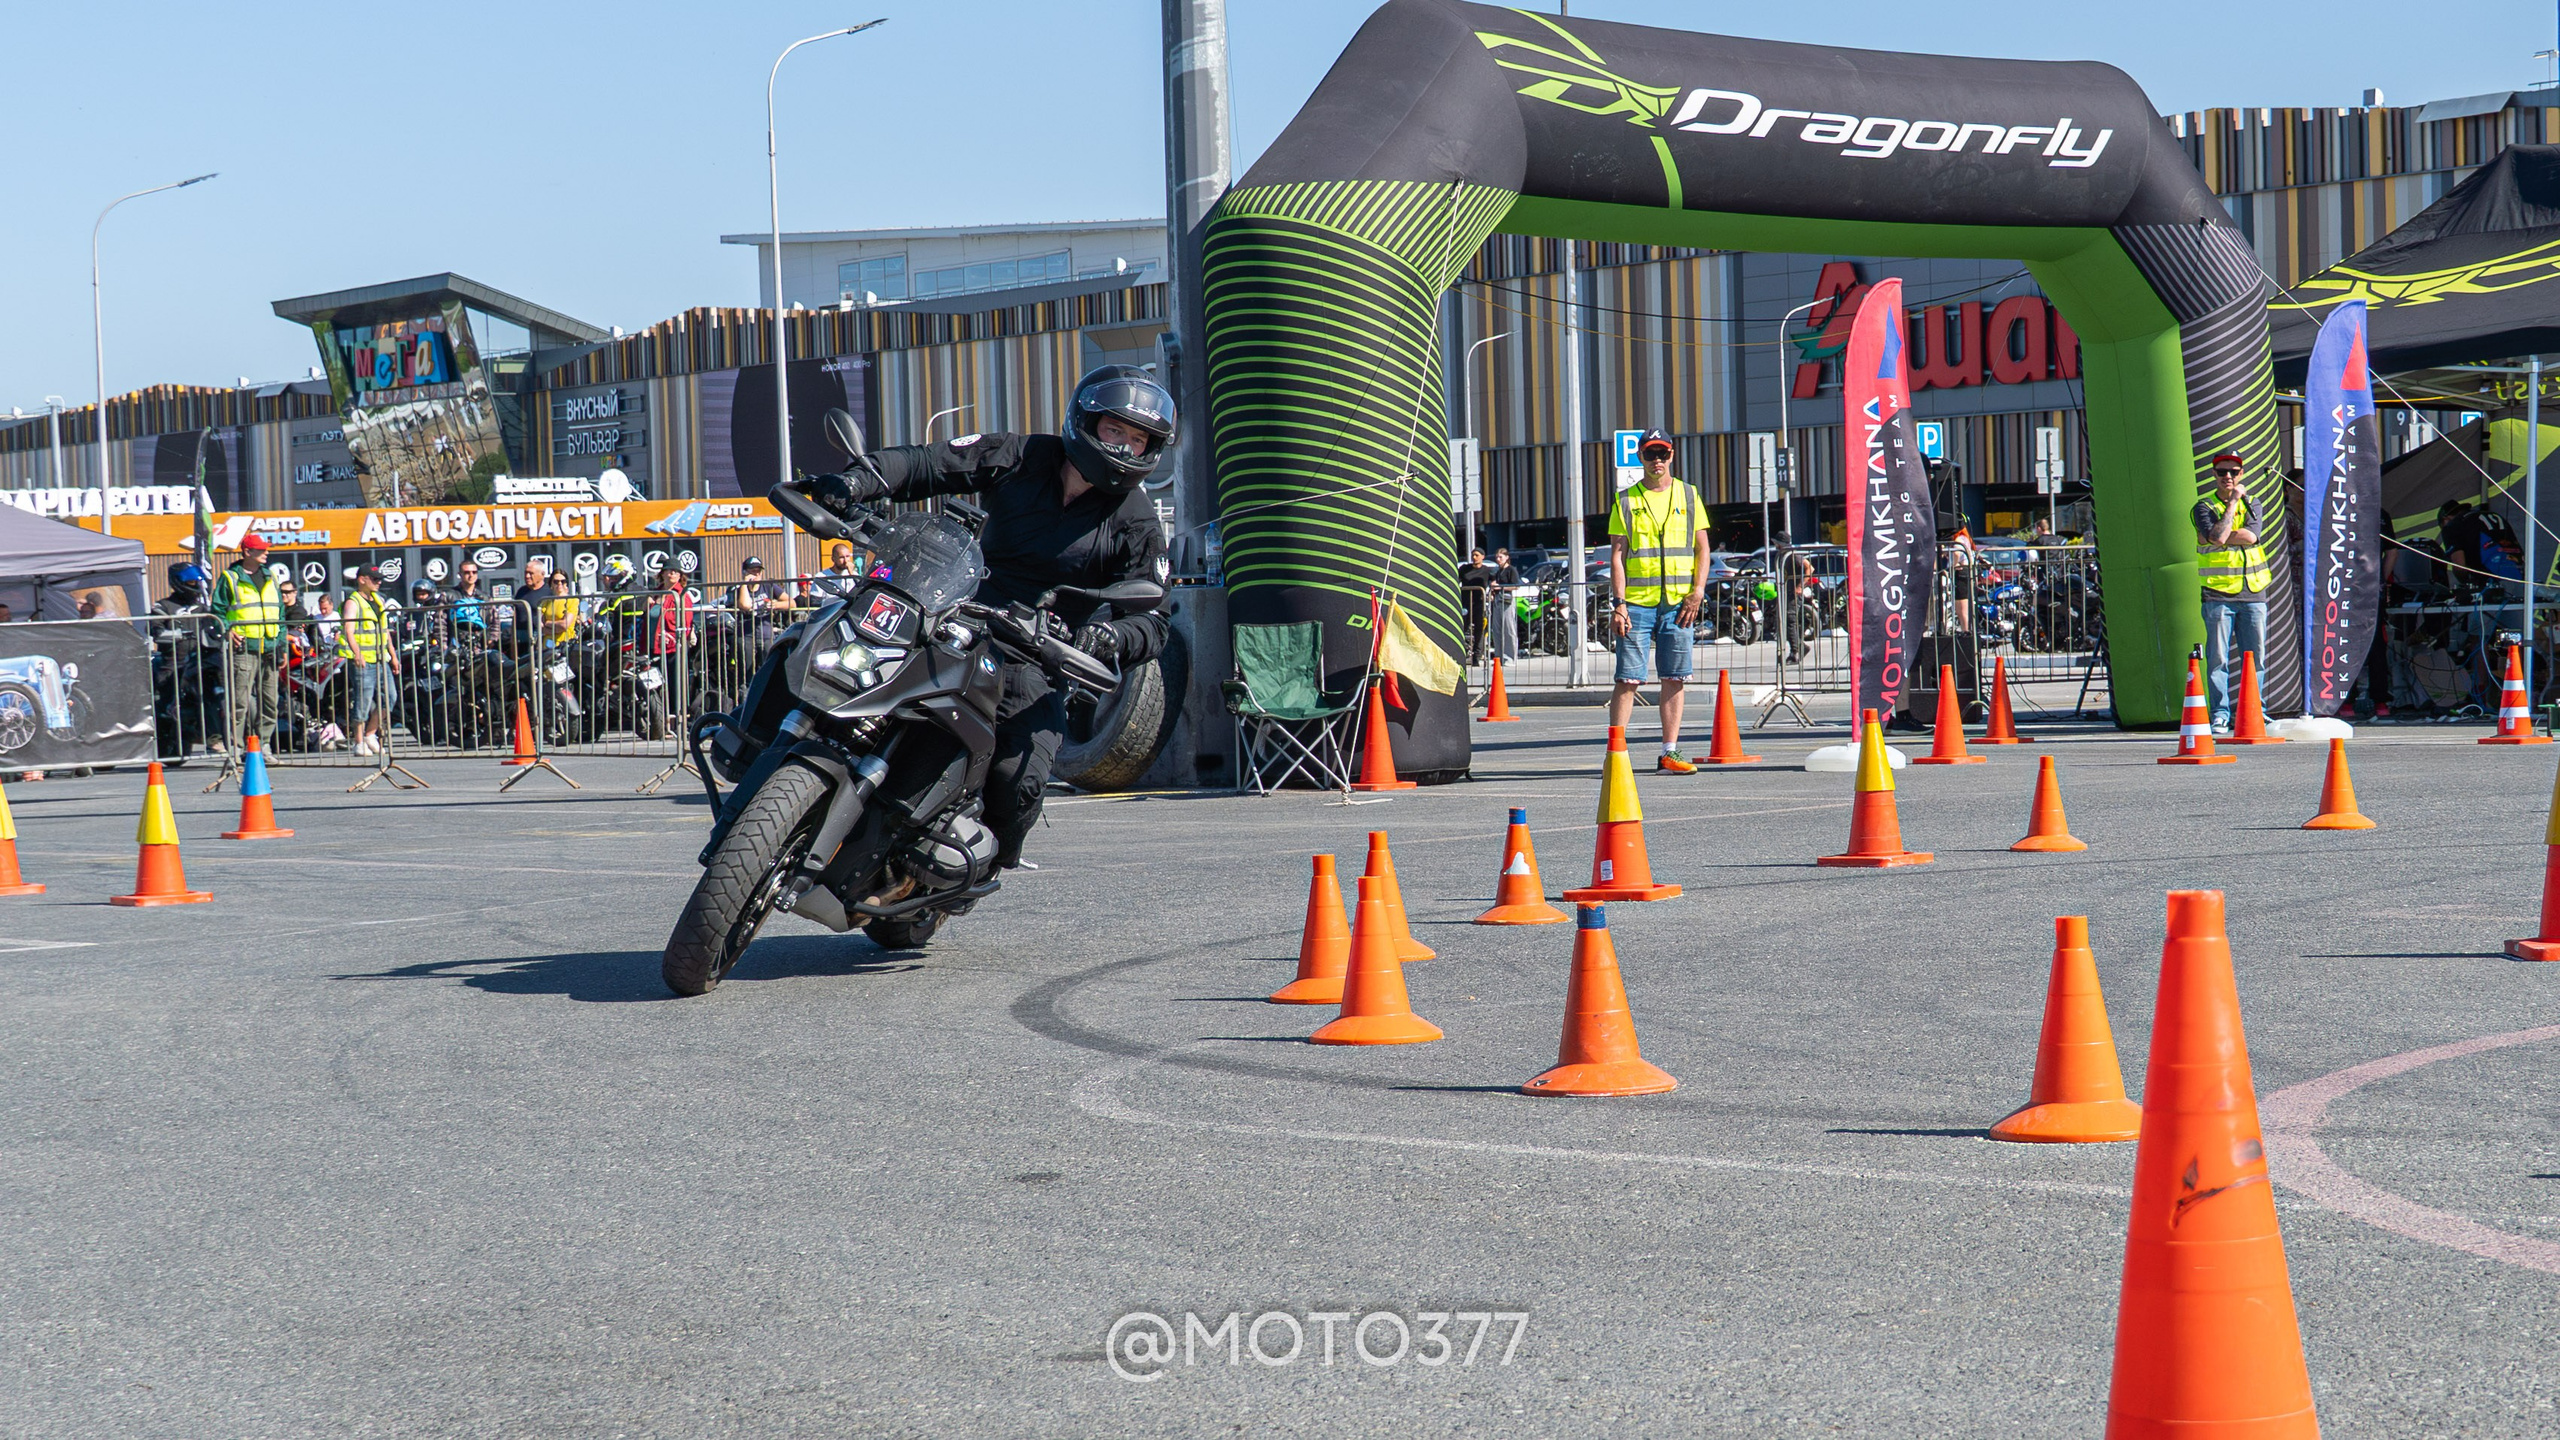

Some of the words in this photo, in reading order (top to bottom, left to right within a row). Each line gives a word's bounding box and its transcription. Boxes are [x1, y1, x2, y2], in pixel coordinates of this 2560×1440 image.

[1673, 88, 2113, 168] Dragonfly
[567, 388, 618, 421] ВКУСНЫЙ
[1889, 394, 1906, 468] TEAM
[1923, 427, 1938, 455] P
[2346, 404, 2356, 471] TEAM
[1622, 434, 1640, 464] P
[251, 516, 304, 531] АВТО
[360, 506, 623, 544] АВТОЗАПЧАСТИ
[705, 516, 783, 530] ЕВРОПЕЕ
[708, 504, 753, 516] АВТО
[252, 530, 331, 544] ПОНЕЦ
[2320, 404, 2347, 699] MOTOGYMKHANA
[2339, 494, 2357, 699] EKATERINBURG
[876, 609, 899, 632] 41
